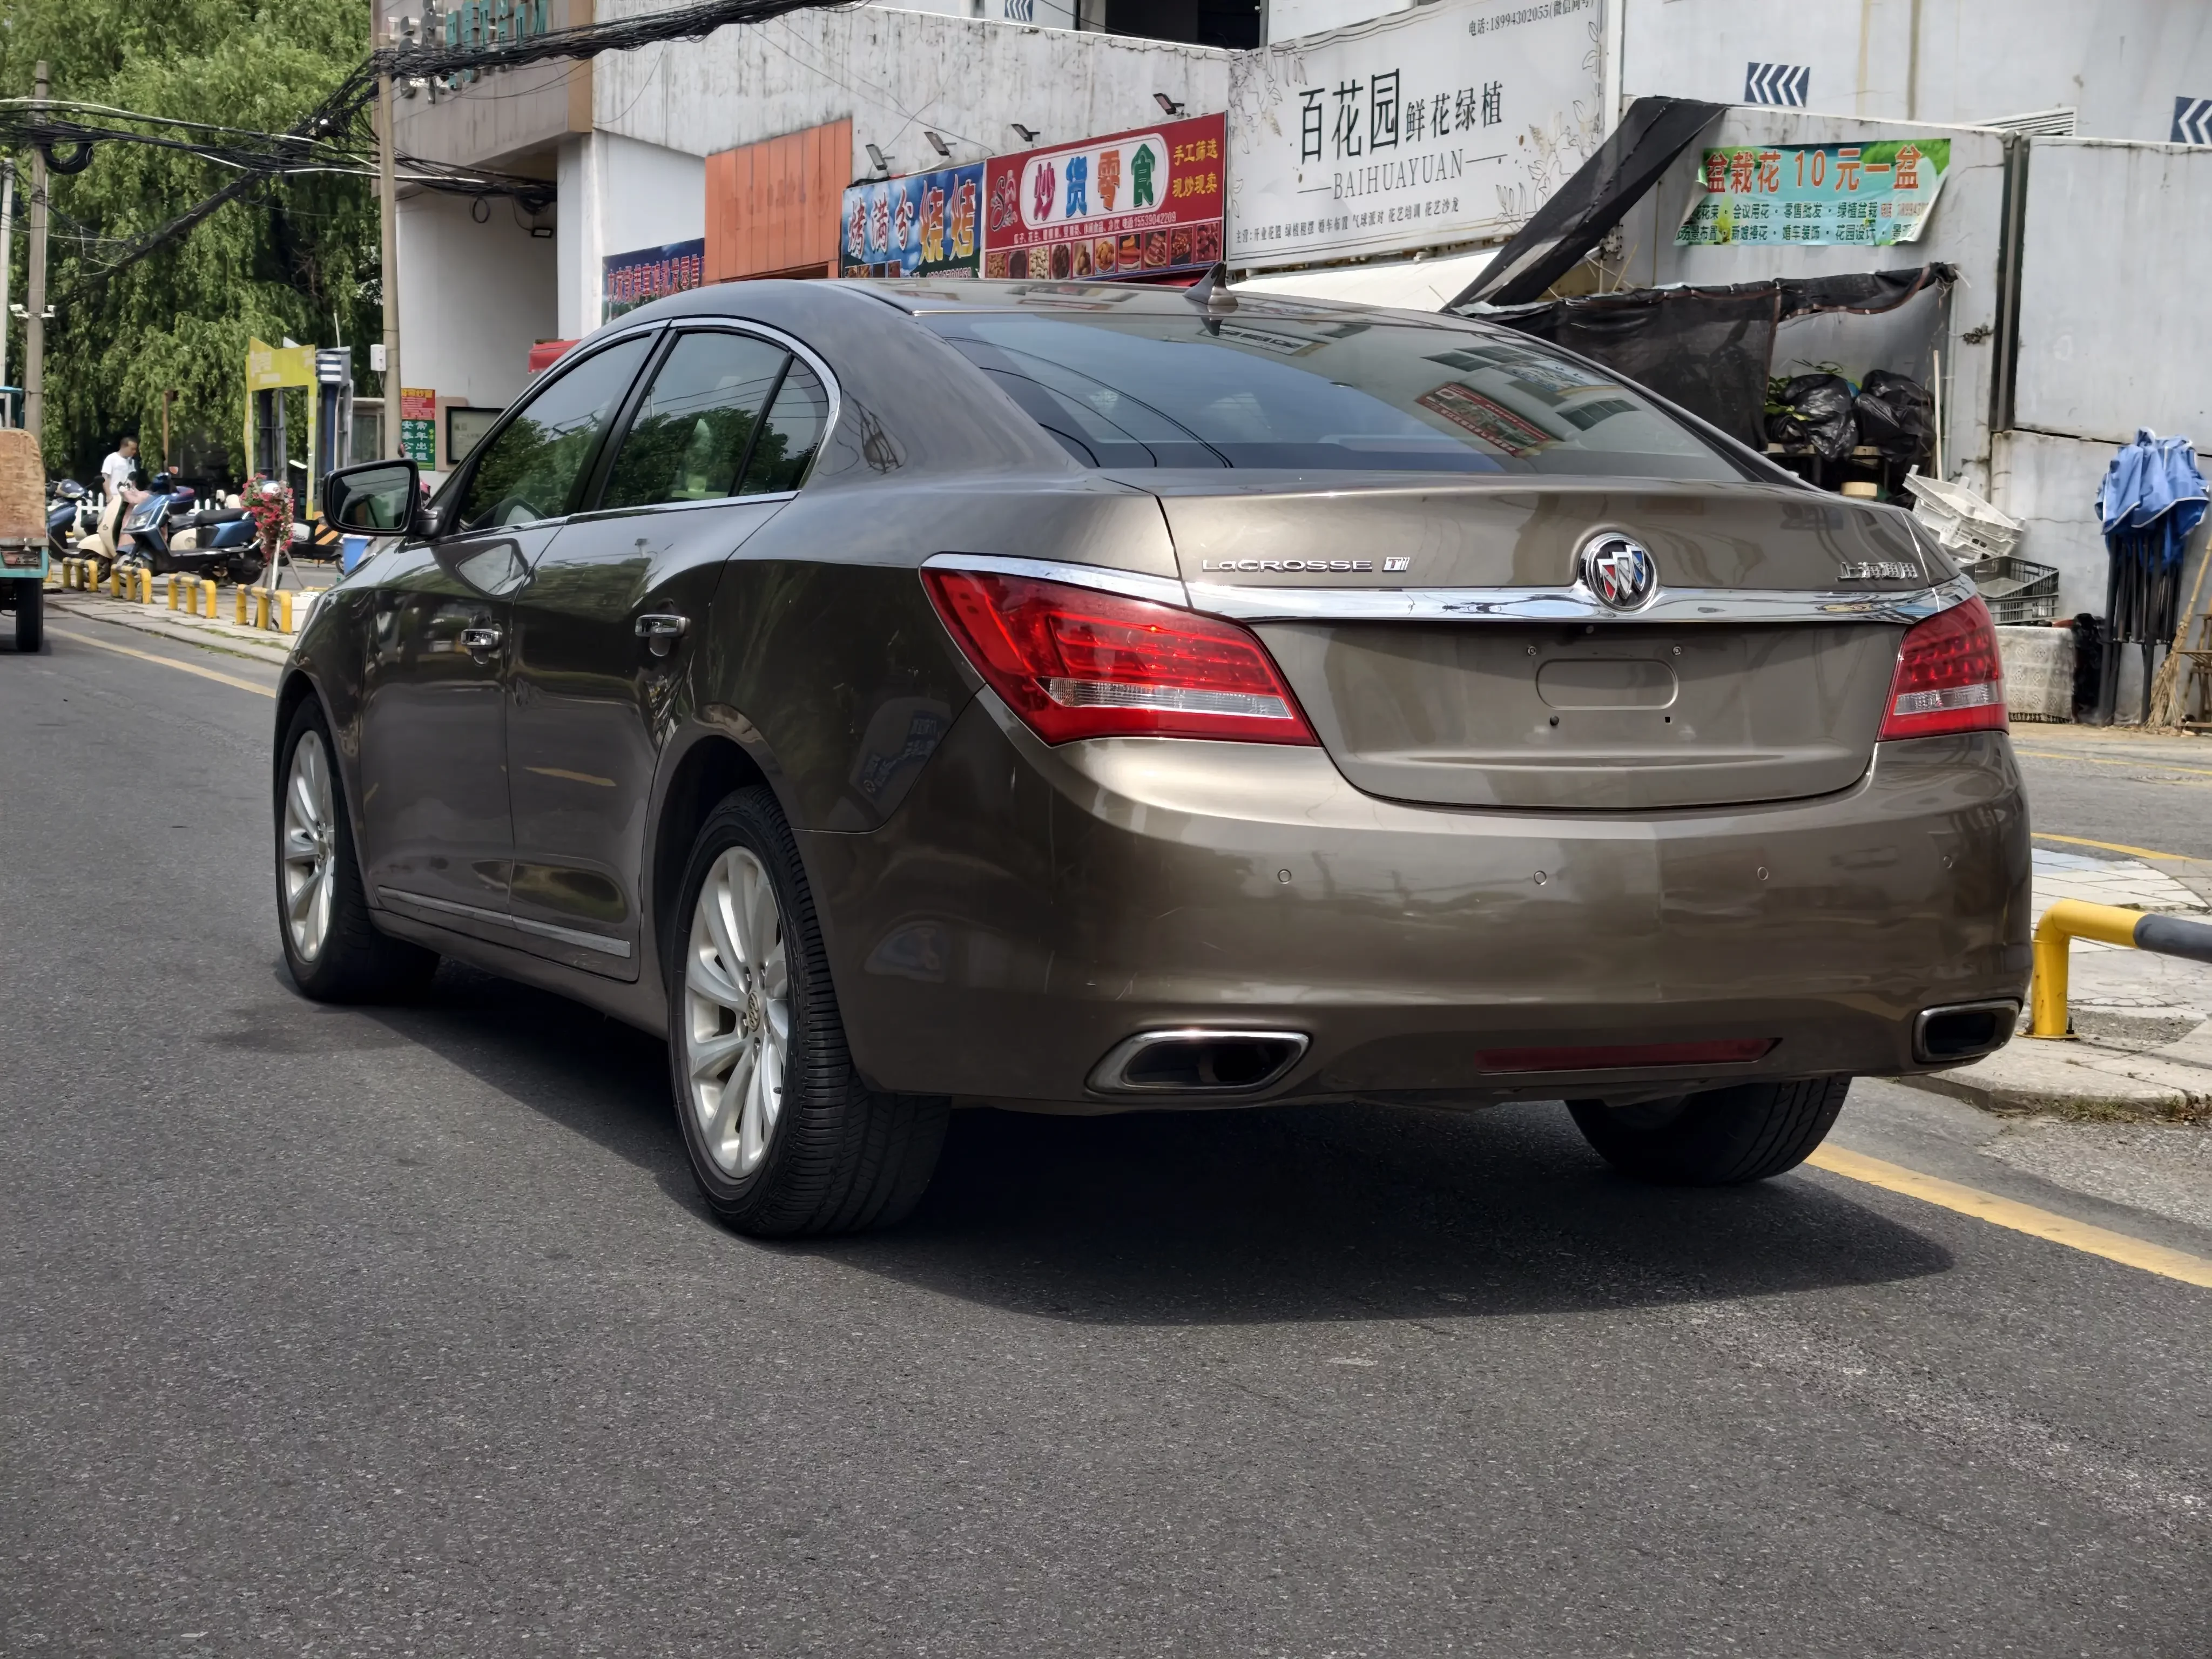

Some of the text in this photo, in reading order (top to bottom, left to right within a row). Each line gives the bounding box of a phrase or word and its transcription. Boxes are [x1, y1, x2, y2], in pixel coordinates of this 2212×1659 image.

[1299, 68, 1503, 165] 百花园 鲜花绿植
[1033, 143, 1156, 221] 炒货零食
[1172, 172, 1218, 198] 现炒现卖
[1333, 149, 1464, 200] BAIHUAYUAN
[1706, 144, 1923, 193] 盆栽花 10 元一盆
[1733, 203, 1770, 219] 会议用花
[1784, 202, 1823, 219] 零售批发
